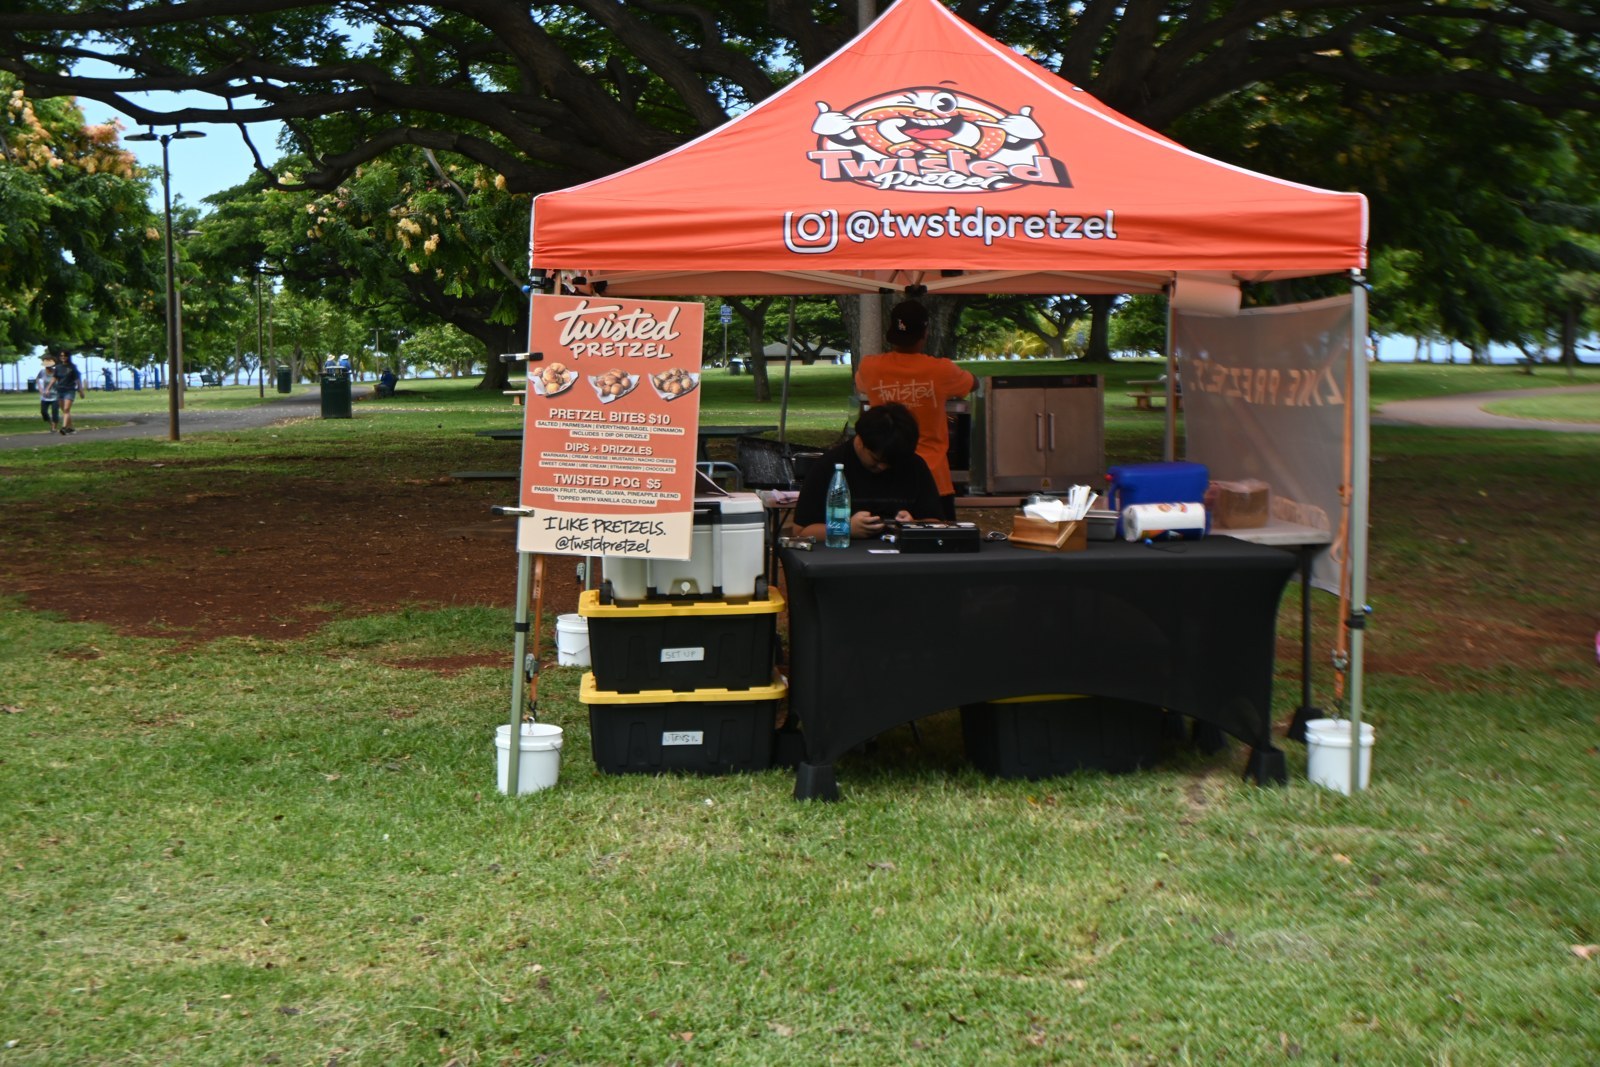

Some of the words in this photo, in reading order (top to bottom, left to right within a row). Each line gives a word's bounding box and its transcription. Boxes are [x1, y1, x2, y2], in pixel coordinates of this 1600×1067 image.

[806, 148, 1066, 187] Twisted
[876, 170, 1005, 190] Pretzel
[844, 206, 1118, 246] @twstdpretzel
[570, 342, 673, 359] PRETZEL
[549, 408, 607, 421] PRETZEL
[609, 411, 647, 424] BITES
[648, 413, 671, 426] $10
[565, 442, 590, 453] DIPS
[592, 445, 599, 453] +
[601, 444, 654, 456] DRIZZLES
[553, 473, 610, 487] TWISTED
[612, 476, 641, 489] POG
[646, 478, 662, 490] $5
[543, 516, 558, 531] I
[558, 517, 589, 532] LIKE
[591, 518, 667, 536] PRETZELS.
[555, 535, 651, 554] @twstdpretzel
